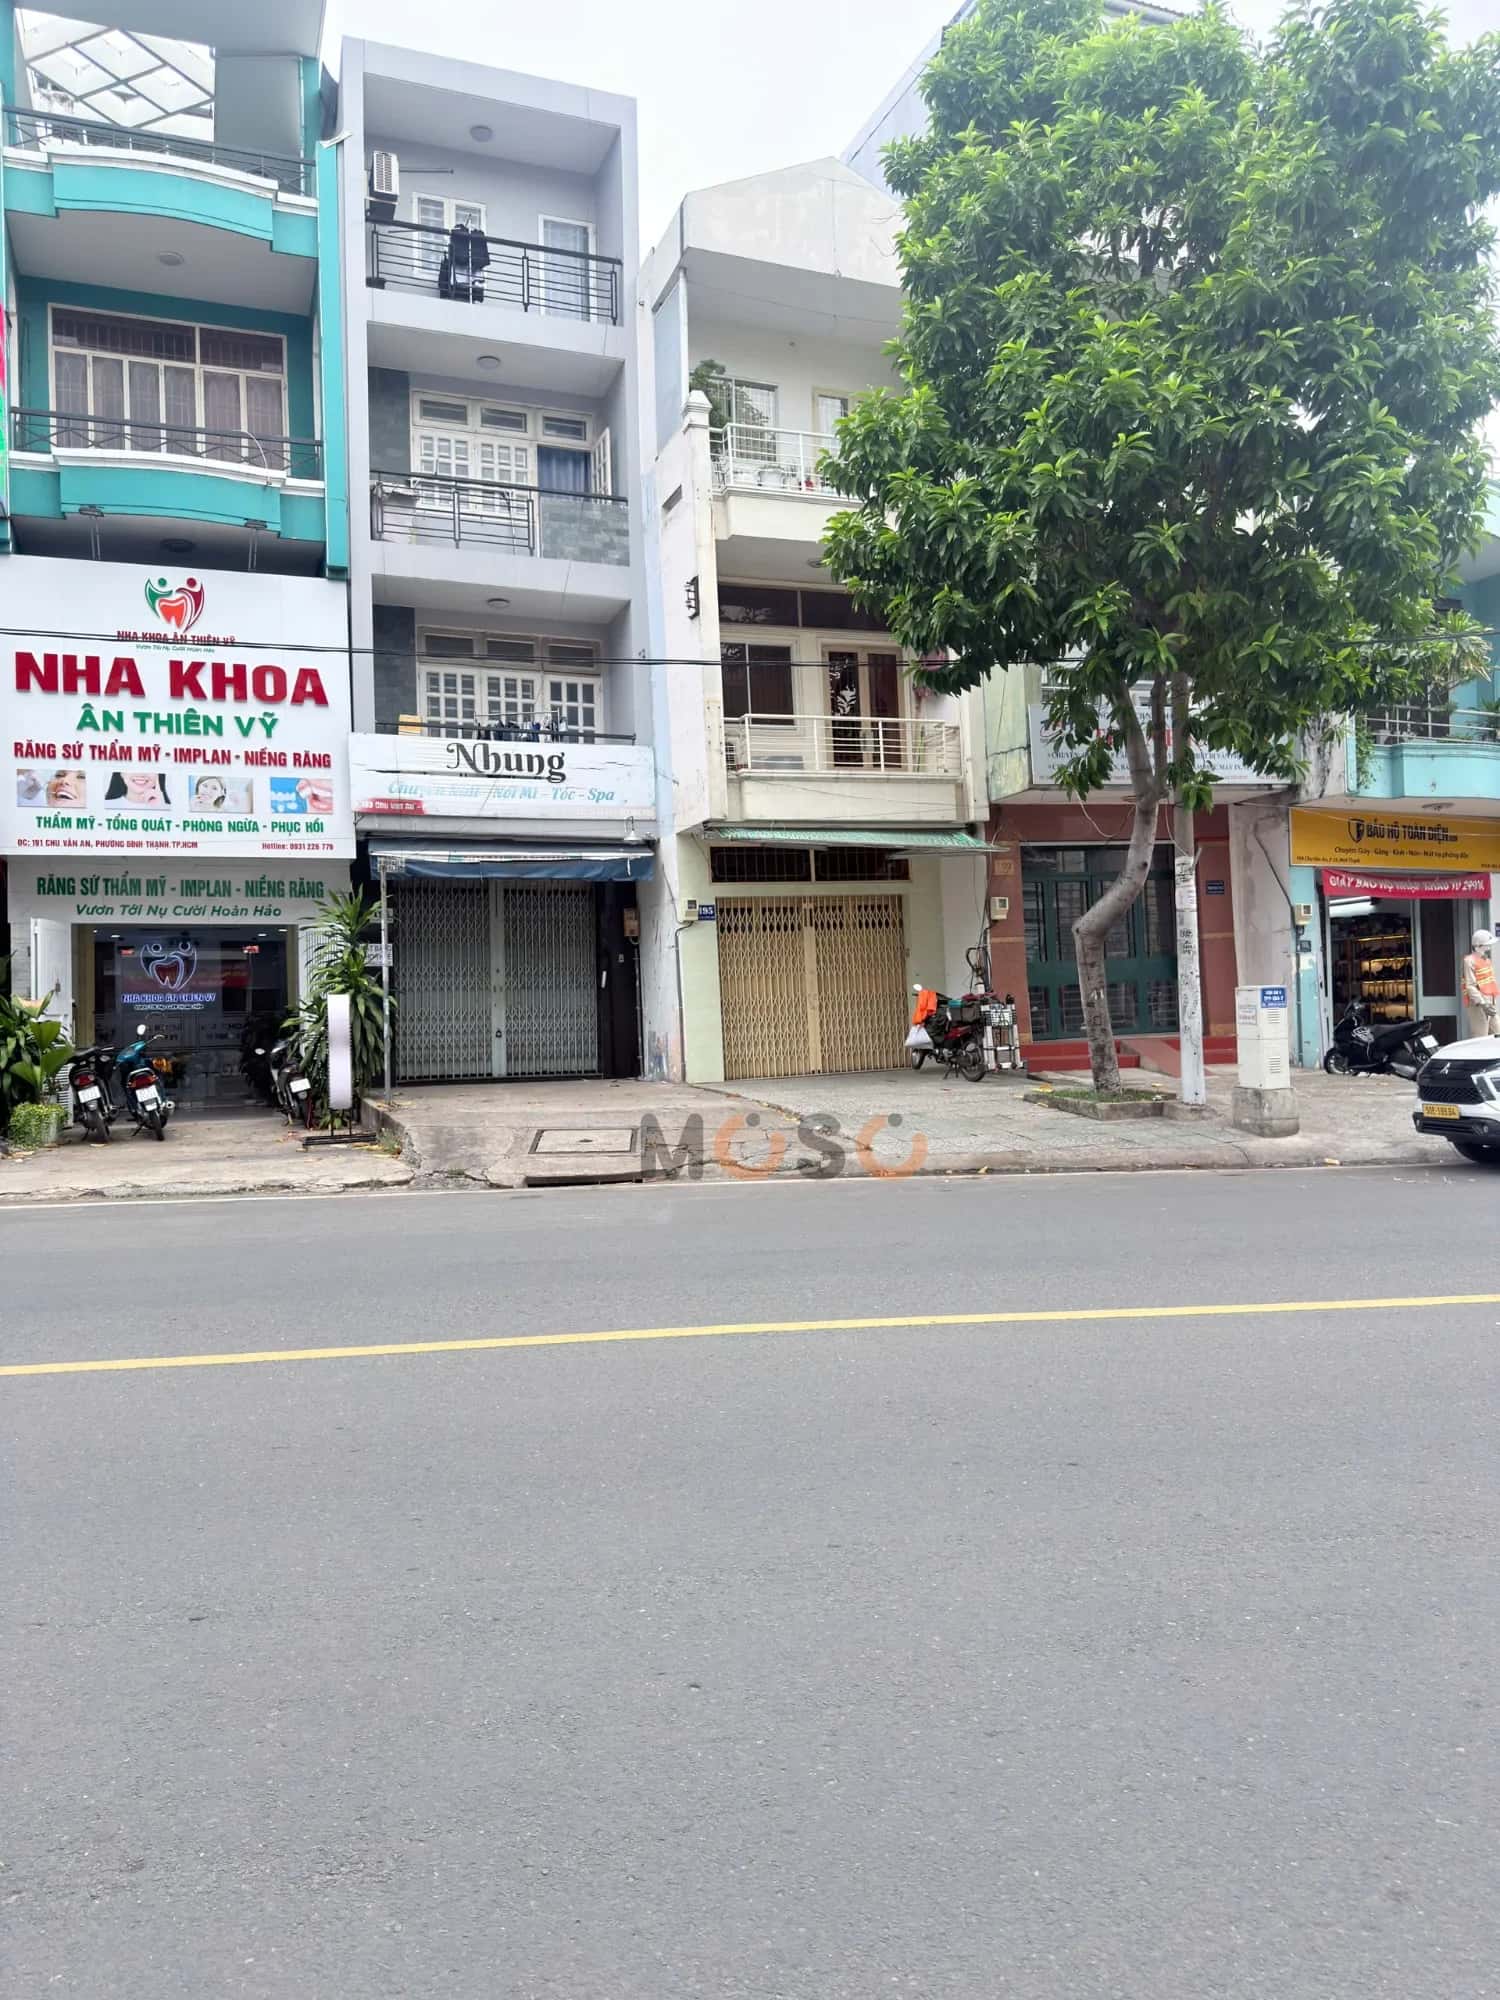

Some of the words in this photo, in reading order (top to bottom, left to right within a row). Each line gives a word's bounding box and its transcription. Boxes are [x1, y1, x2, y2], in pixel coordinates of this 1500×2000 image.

[15, 651, 146, 698] NHA
[169, 659, 329, 707] KHOA
[76, 703, 124, 732] ÂN
[133, 708, 223, 737] THIÊN
[234, 711, 279, 738] VỸ
[13, 739, 57, 760] RĂNG
[61, 740, 84, 760] SỨ
[89, 738, 132, 761] THẨM
[138, 742, 161, 762] MỸ
[173, 747, 231, 766] IMPLAN
[292, 749, 332, 769] RĂNG
[446, 743, 567, 783] Nhung
[552, 787, 576, 800] Tóc
[587, 787, 615, 803] Spa
[35, 811, 72, 829] THẨM
[76, 814, 96, 830] MỸ
[106, 813, 137, 831] TỔNG
[141, 817, 172, 832] QUÁT
[182, 818, 223, 833] PHÒNG
[227, 817, 260, 833] NGỪA
[271, 819, 302, 836] PHỤC
[1366, 818, 1385, 839] BẢO
[1387, 820, 1400, 841] HỘ
[1403, 822, 1426, 841] TOÀN
[36, 876, 76, 896] RĂNG
[80, 876, 99, 896] SỨ
[102, 870, 140, 897] THẨM
[145, 876, 167, 898] MỸ
[180, 879, 233, 898] IMPLAN
[289, 877, 325, 899] RĂNG
[75, 903, 114, 917] Vươn
[120, 903, 141, 917] Tới
[147, 904, 168, 919] Nụ
[172, 903, 207, 917] Cười
[210, 904, 249, 918] Hoàn
[252, 903, 282, 918] Hảo
[699, 907, 714, 915] 195
